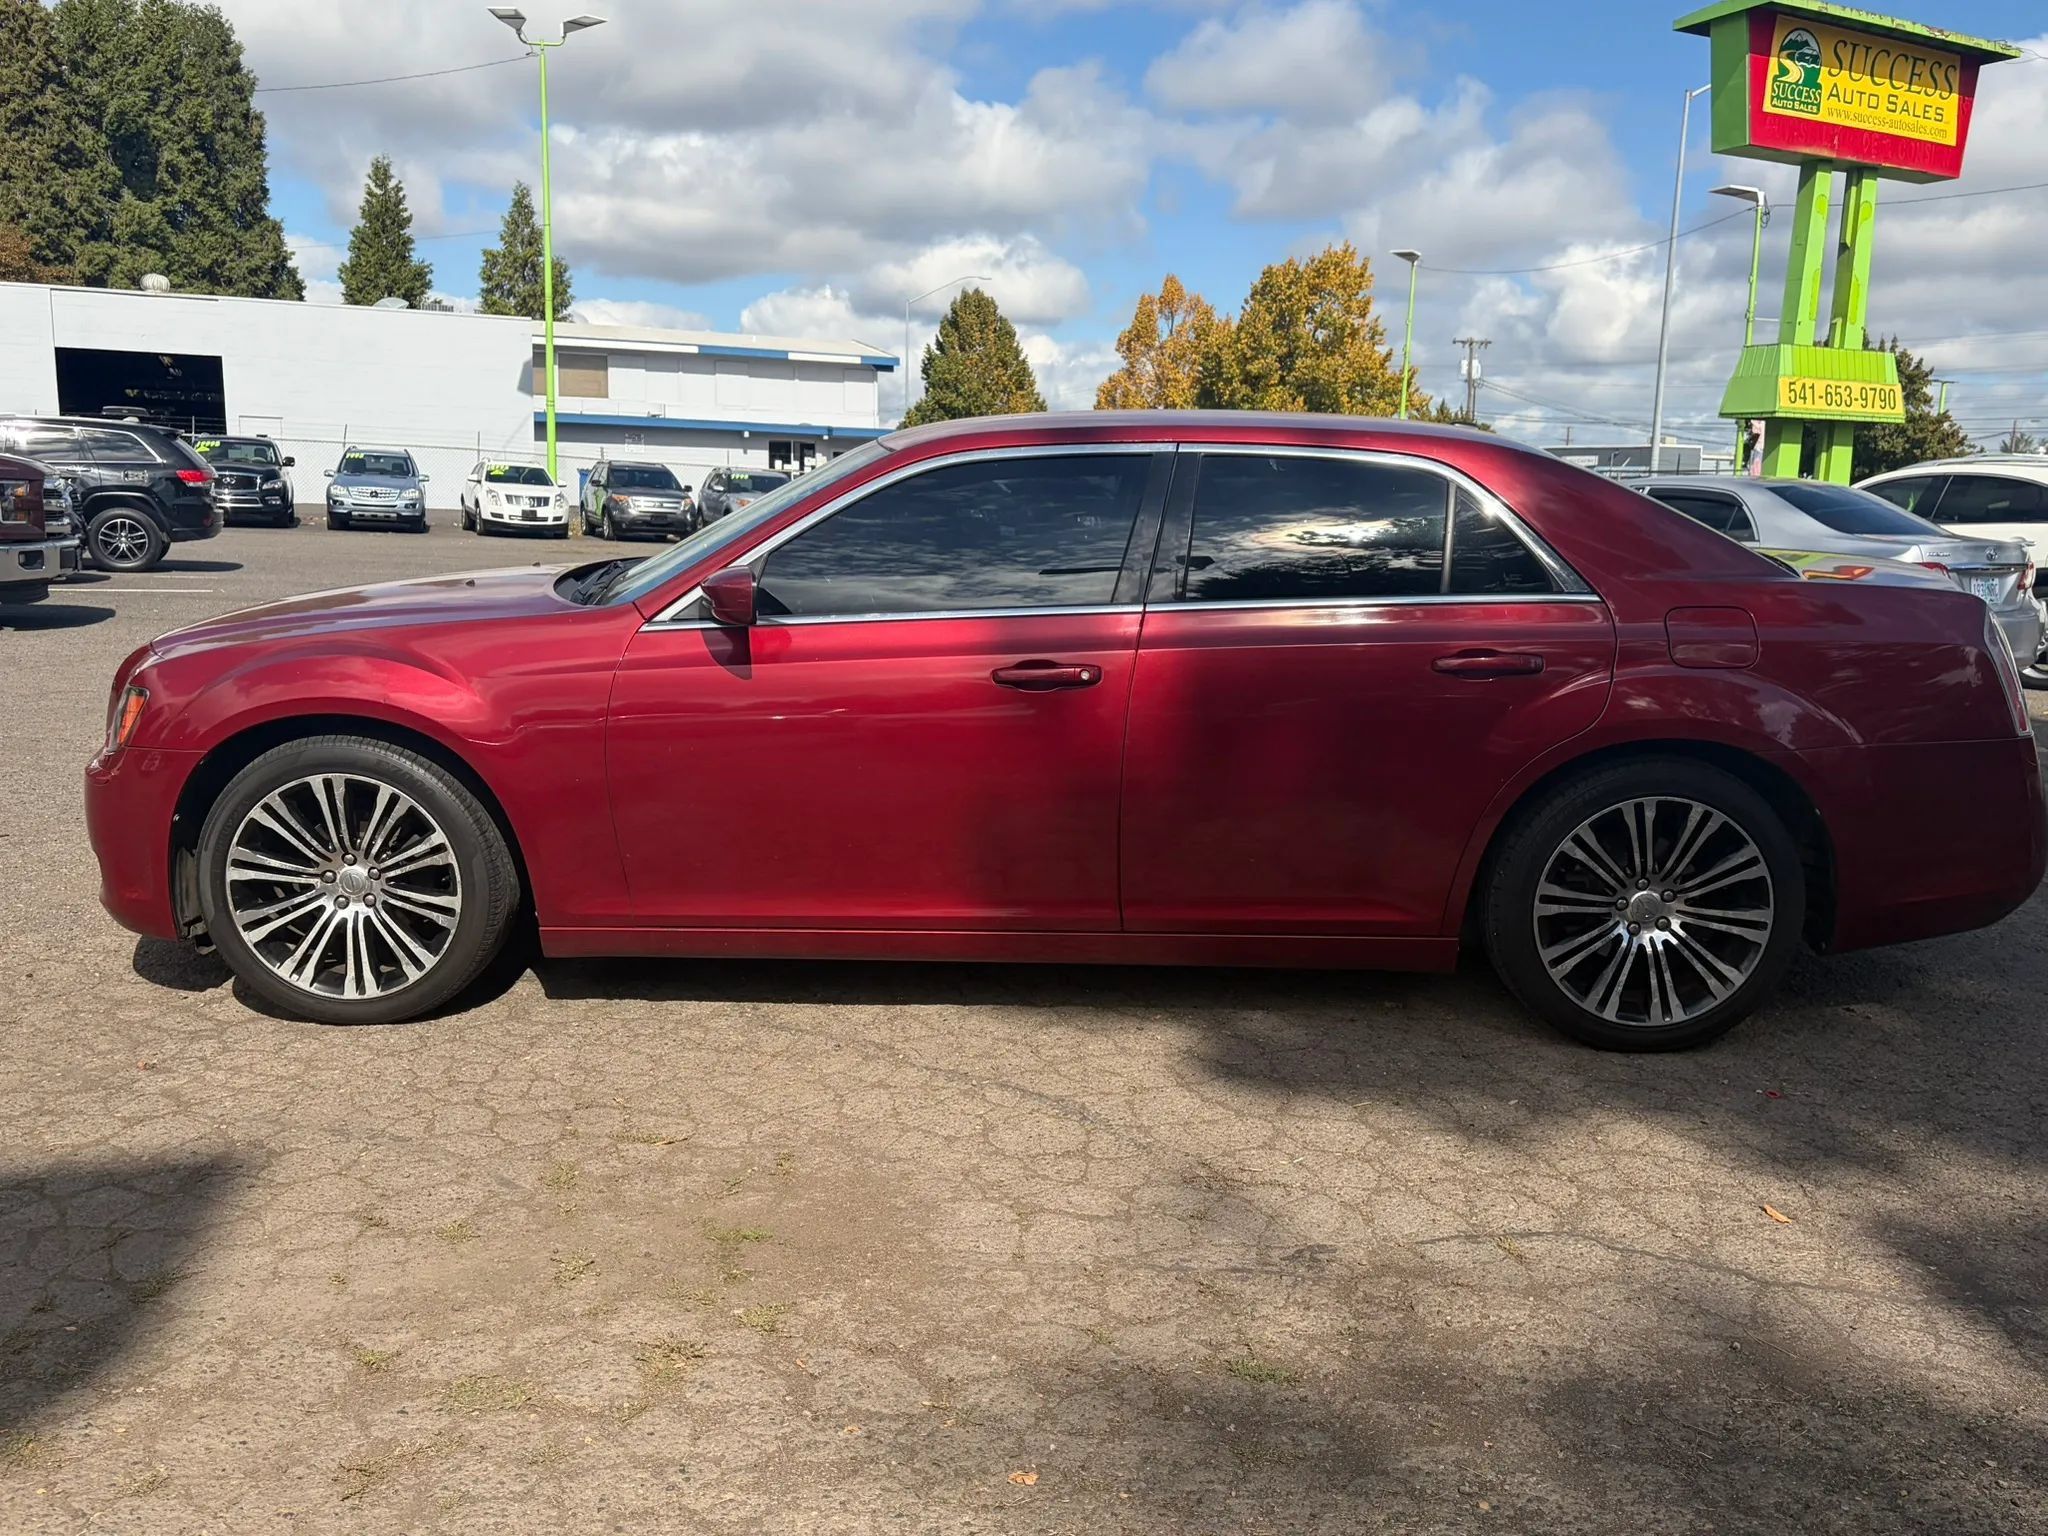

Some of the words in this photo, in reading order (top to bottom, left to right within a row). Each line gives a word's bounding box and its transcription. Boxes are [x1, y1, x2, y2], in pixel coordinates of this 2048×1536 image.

[1827, 39, 1957, 100] SUCCESS
[1772, 82, 1822, 103] SUCCESS
[1827, 107, 1948, 139] www.success-autosales.com
[1788, 381, 1897, 410] 541-653-9790
